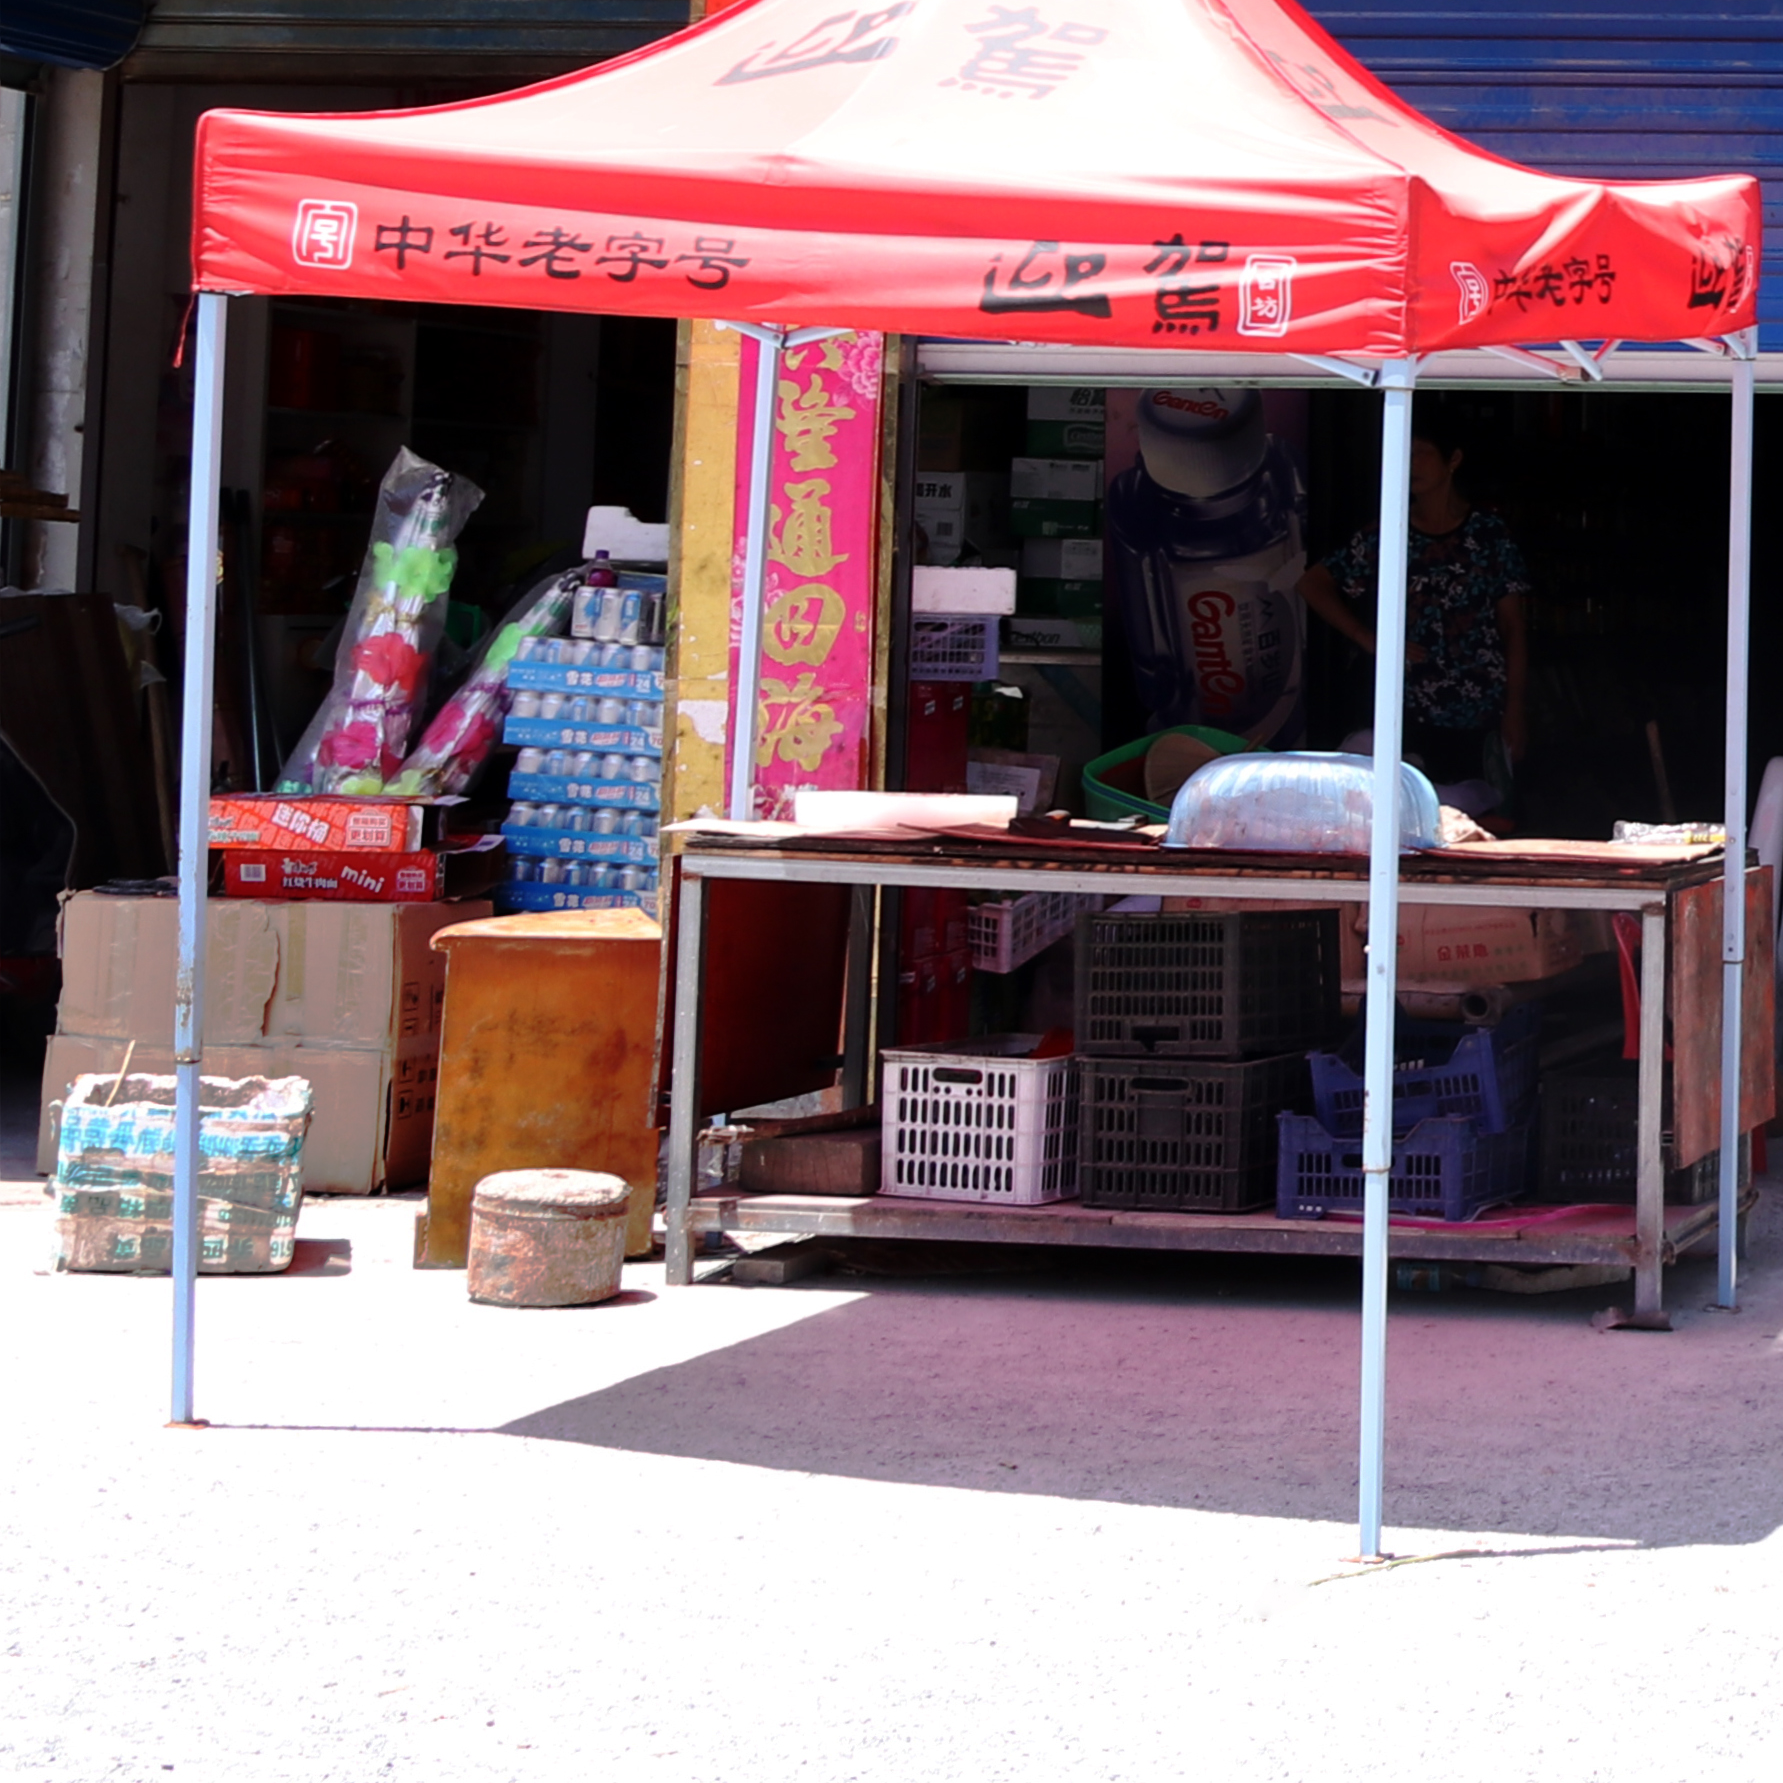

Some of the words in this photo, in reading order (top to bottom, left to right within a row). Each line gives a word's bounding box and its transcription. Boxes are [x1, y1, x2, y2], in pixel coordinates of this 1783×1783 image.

[373, 215, 750, 291] 中华老字号
[566, 670, 594, 687] 雪花
[561, 728, 588, 745] 雪花
[567, 783, 593, 798] 雪花
[271, 802, 331, 845] 迷你桶
[559, 837, 586, 854] 雪花
[341, 866, 385, 893] mini
[555, 892, 579, 908] 雪花
